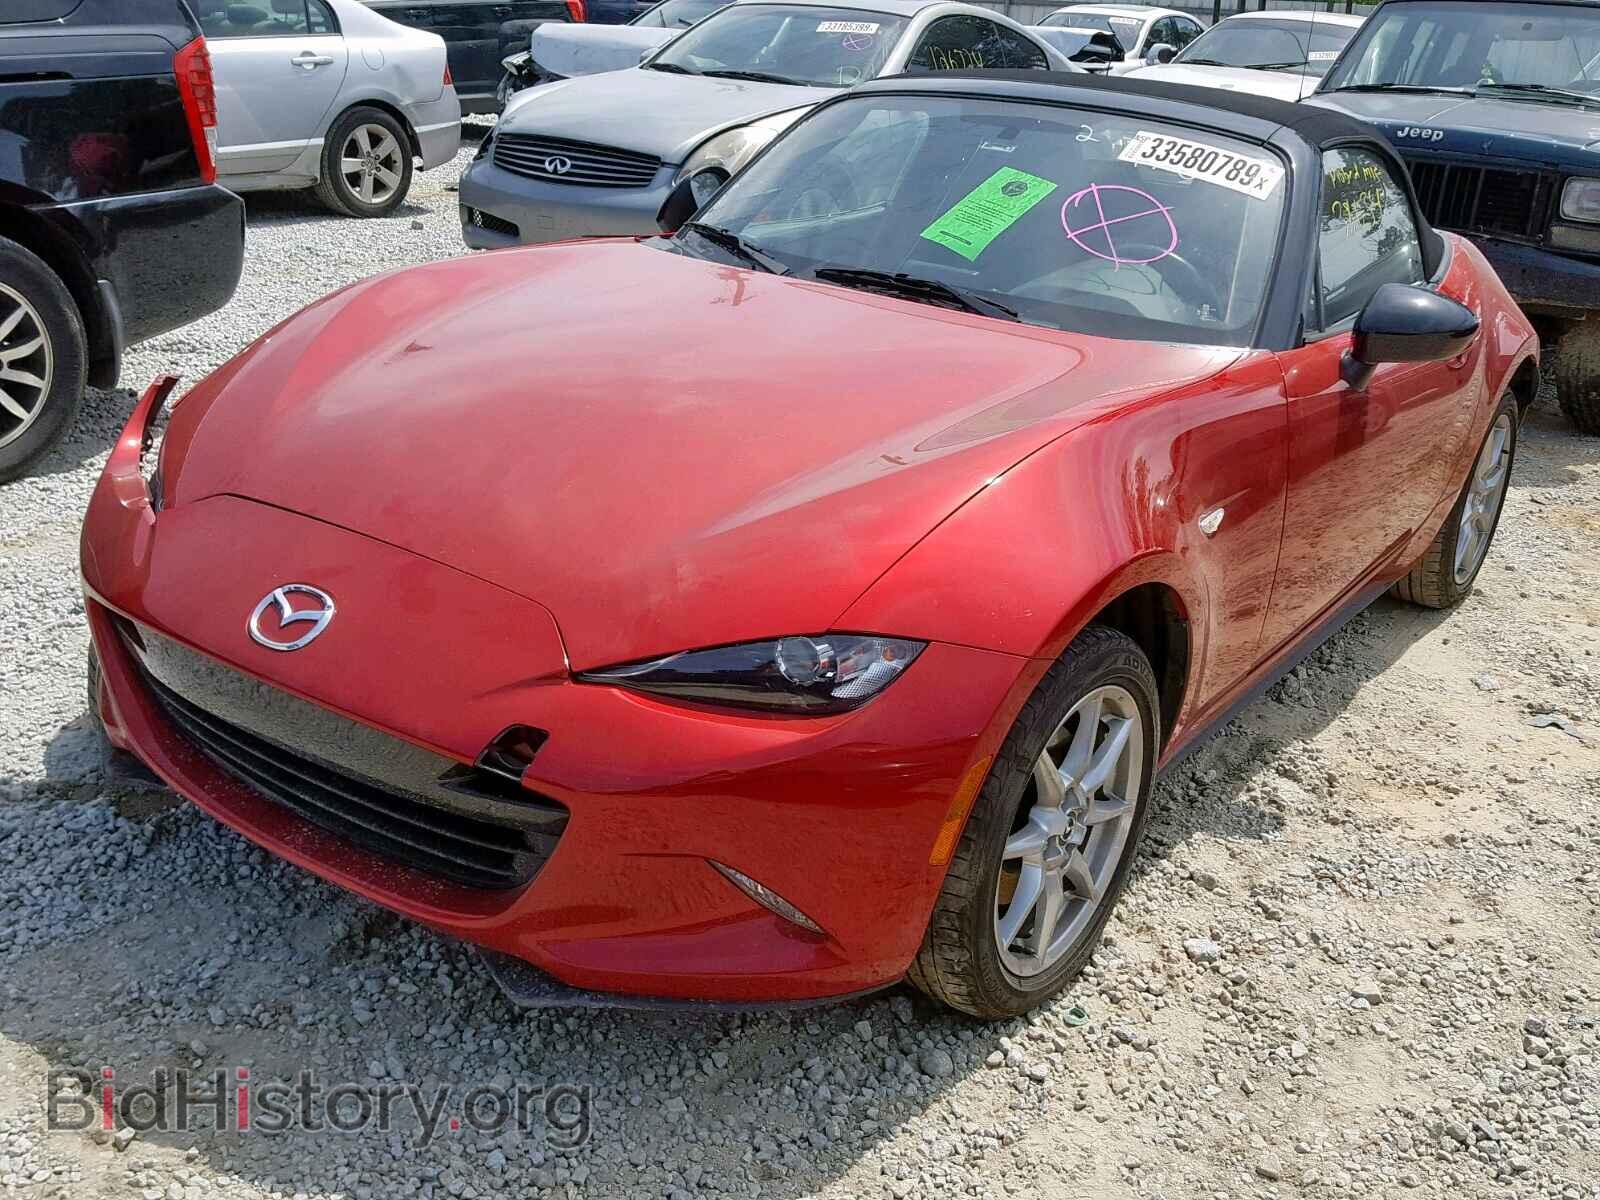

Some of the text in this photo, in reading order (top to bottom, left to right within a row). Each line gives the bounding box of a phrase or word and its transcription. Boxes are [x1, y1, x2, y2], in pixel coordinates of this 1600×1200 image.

[1075, 124, 1100, 141] 2
[1397, 126, 1444, 141] Jeep
[1141, 137, 1261, 186] 33580789
